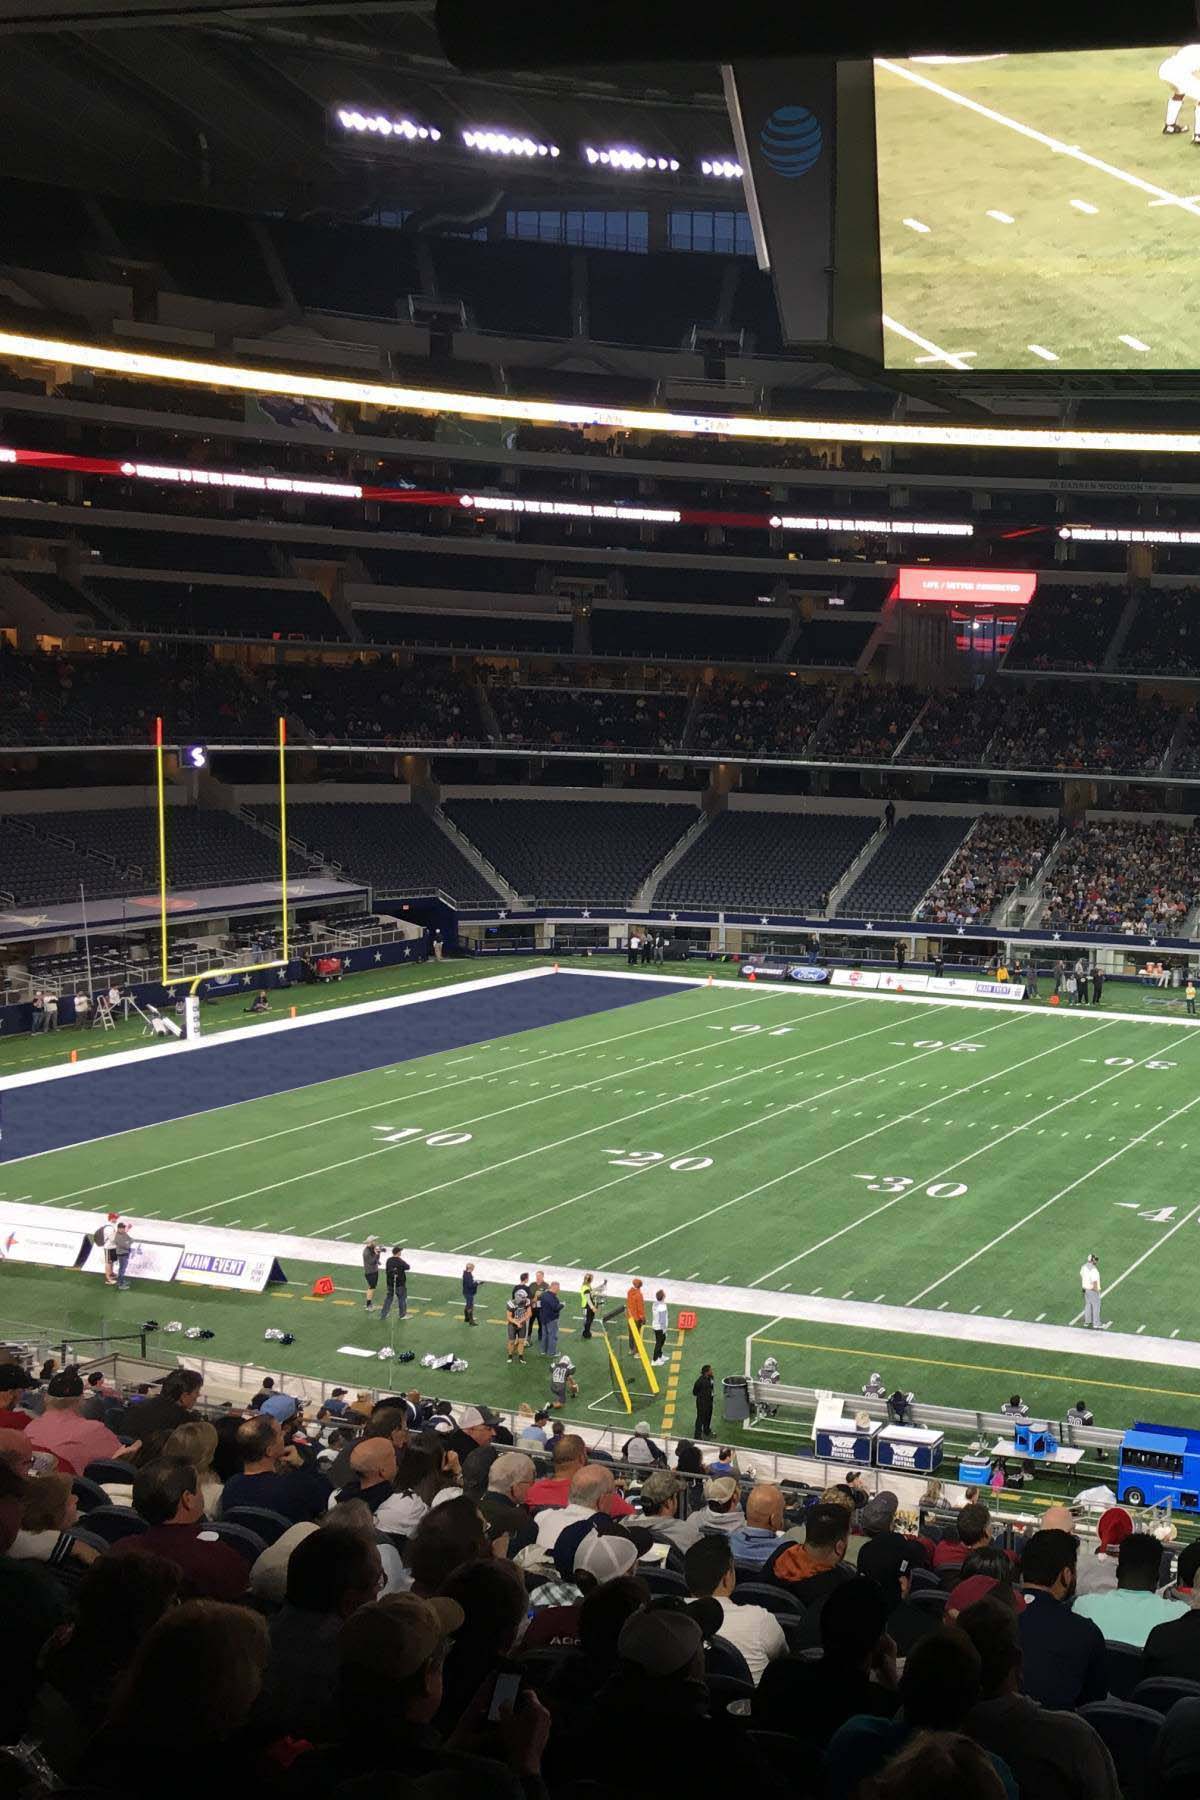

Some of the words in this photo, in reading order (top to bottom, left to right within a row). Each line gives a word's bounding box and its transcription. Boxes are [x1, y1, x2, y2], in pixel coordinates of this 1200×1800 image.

[374, 1128, 472, 1146] 10
[608, 1151, 713, 1171] 20
[867, 1177, 968, 1197] 30
[184, 1253, 211, 1271] MAIN
[212, 1257, 245, 1275] EVENT
